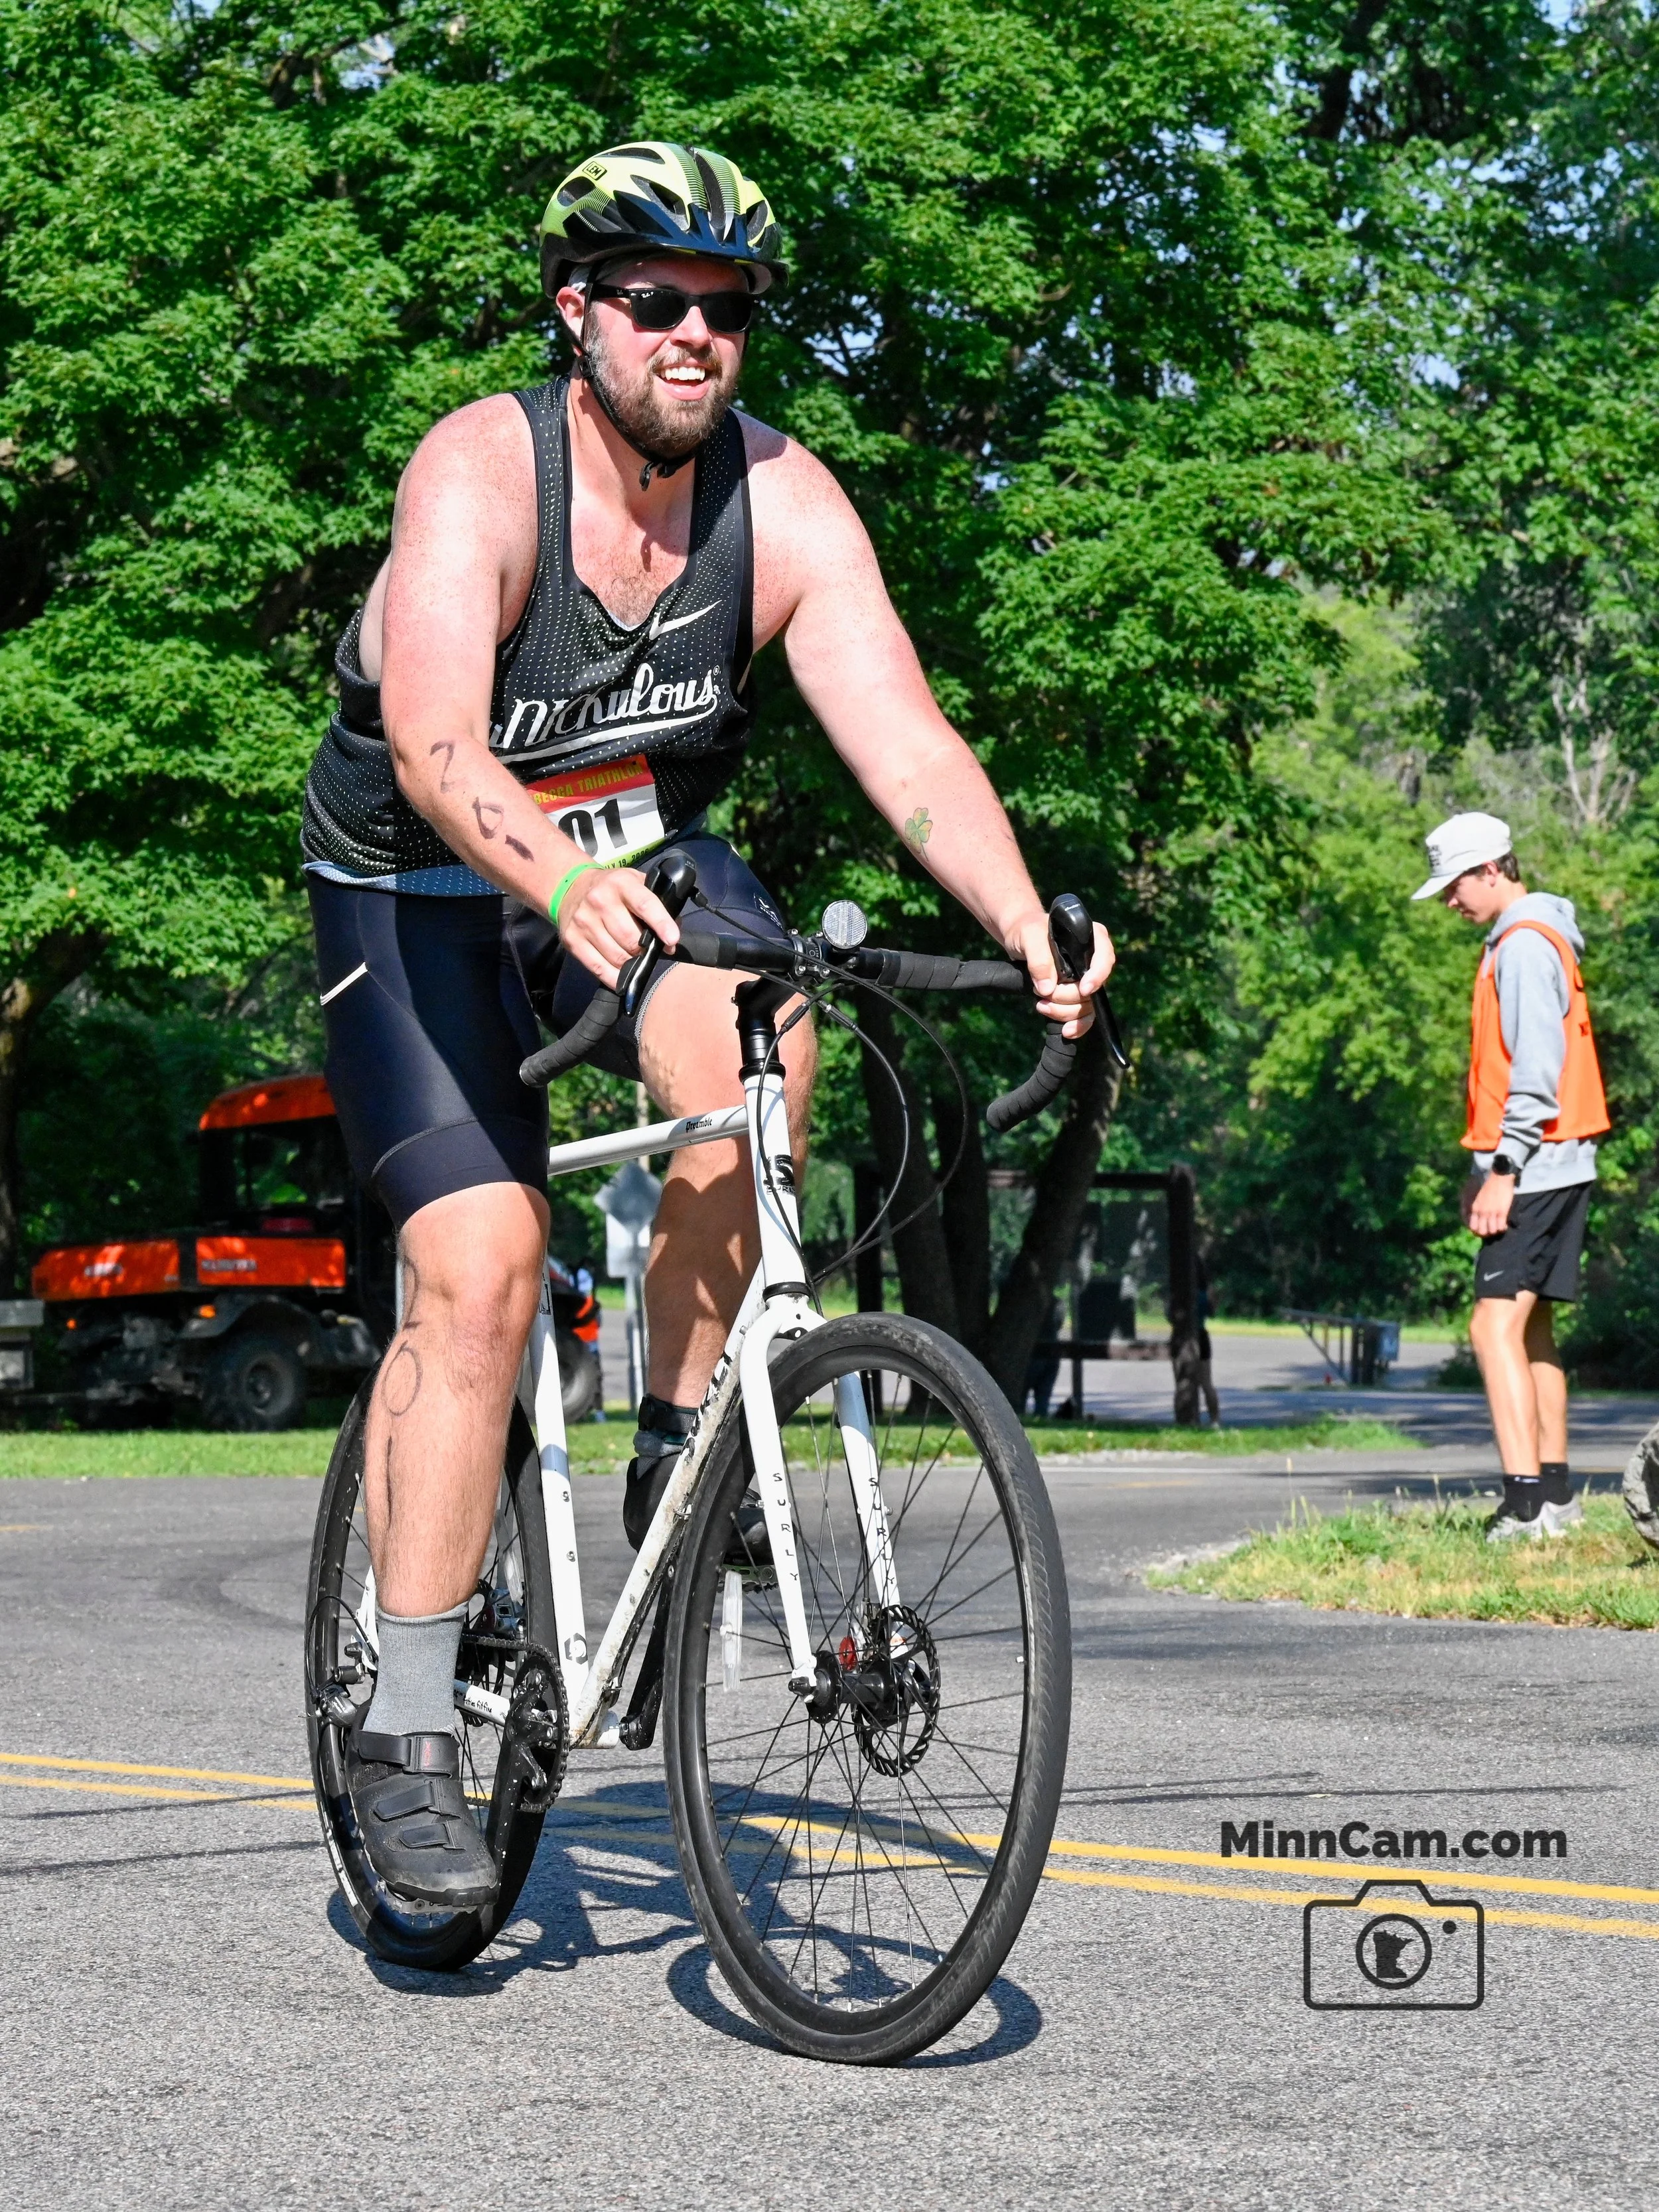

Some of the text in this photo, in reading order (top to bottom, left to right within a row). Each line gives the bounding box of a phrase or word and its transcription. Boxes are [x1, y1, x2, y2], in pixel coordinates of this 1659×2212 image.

[587, 164, 602, 176] LEM
[533, 763, 642, 805] BECCA TRIATHLON
[558, 798, 628, 858] 01
[685, 1117, 713, 1134] Preamble
[772, 1472, 799, 1581] SURLY
